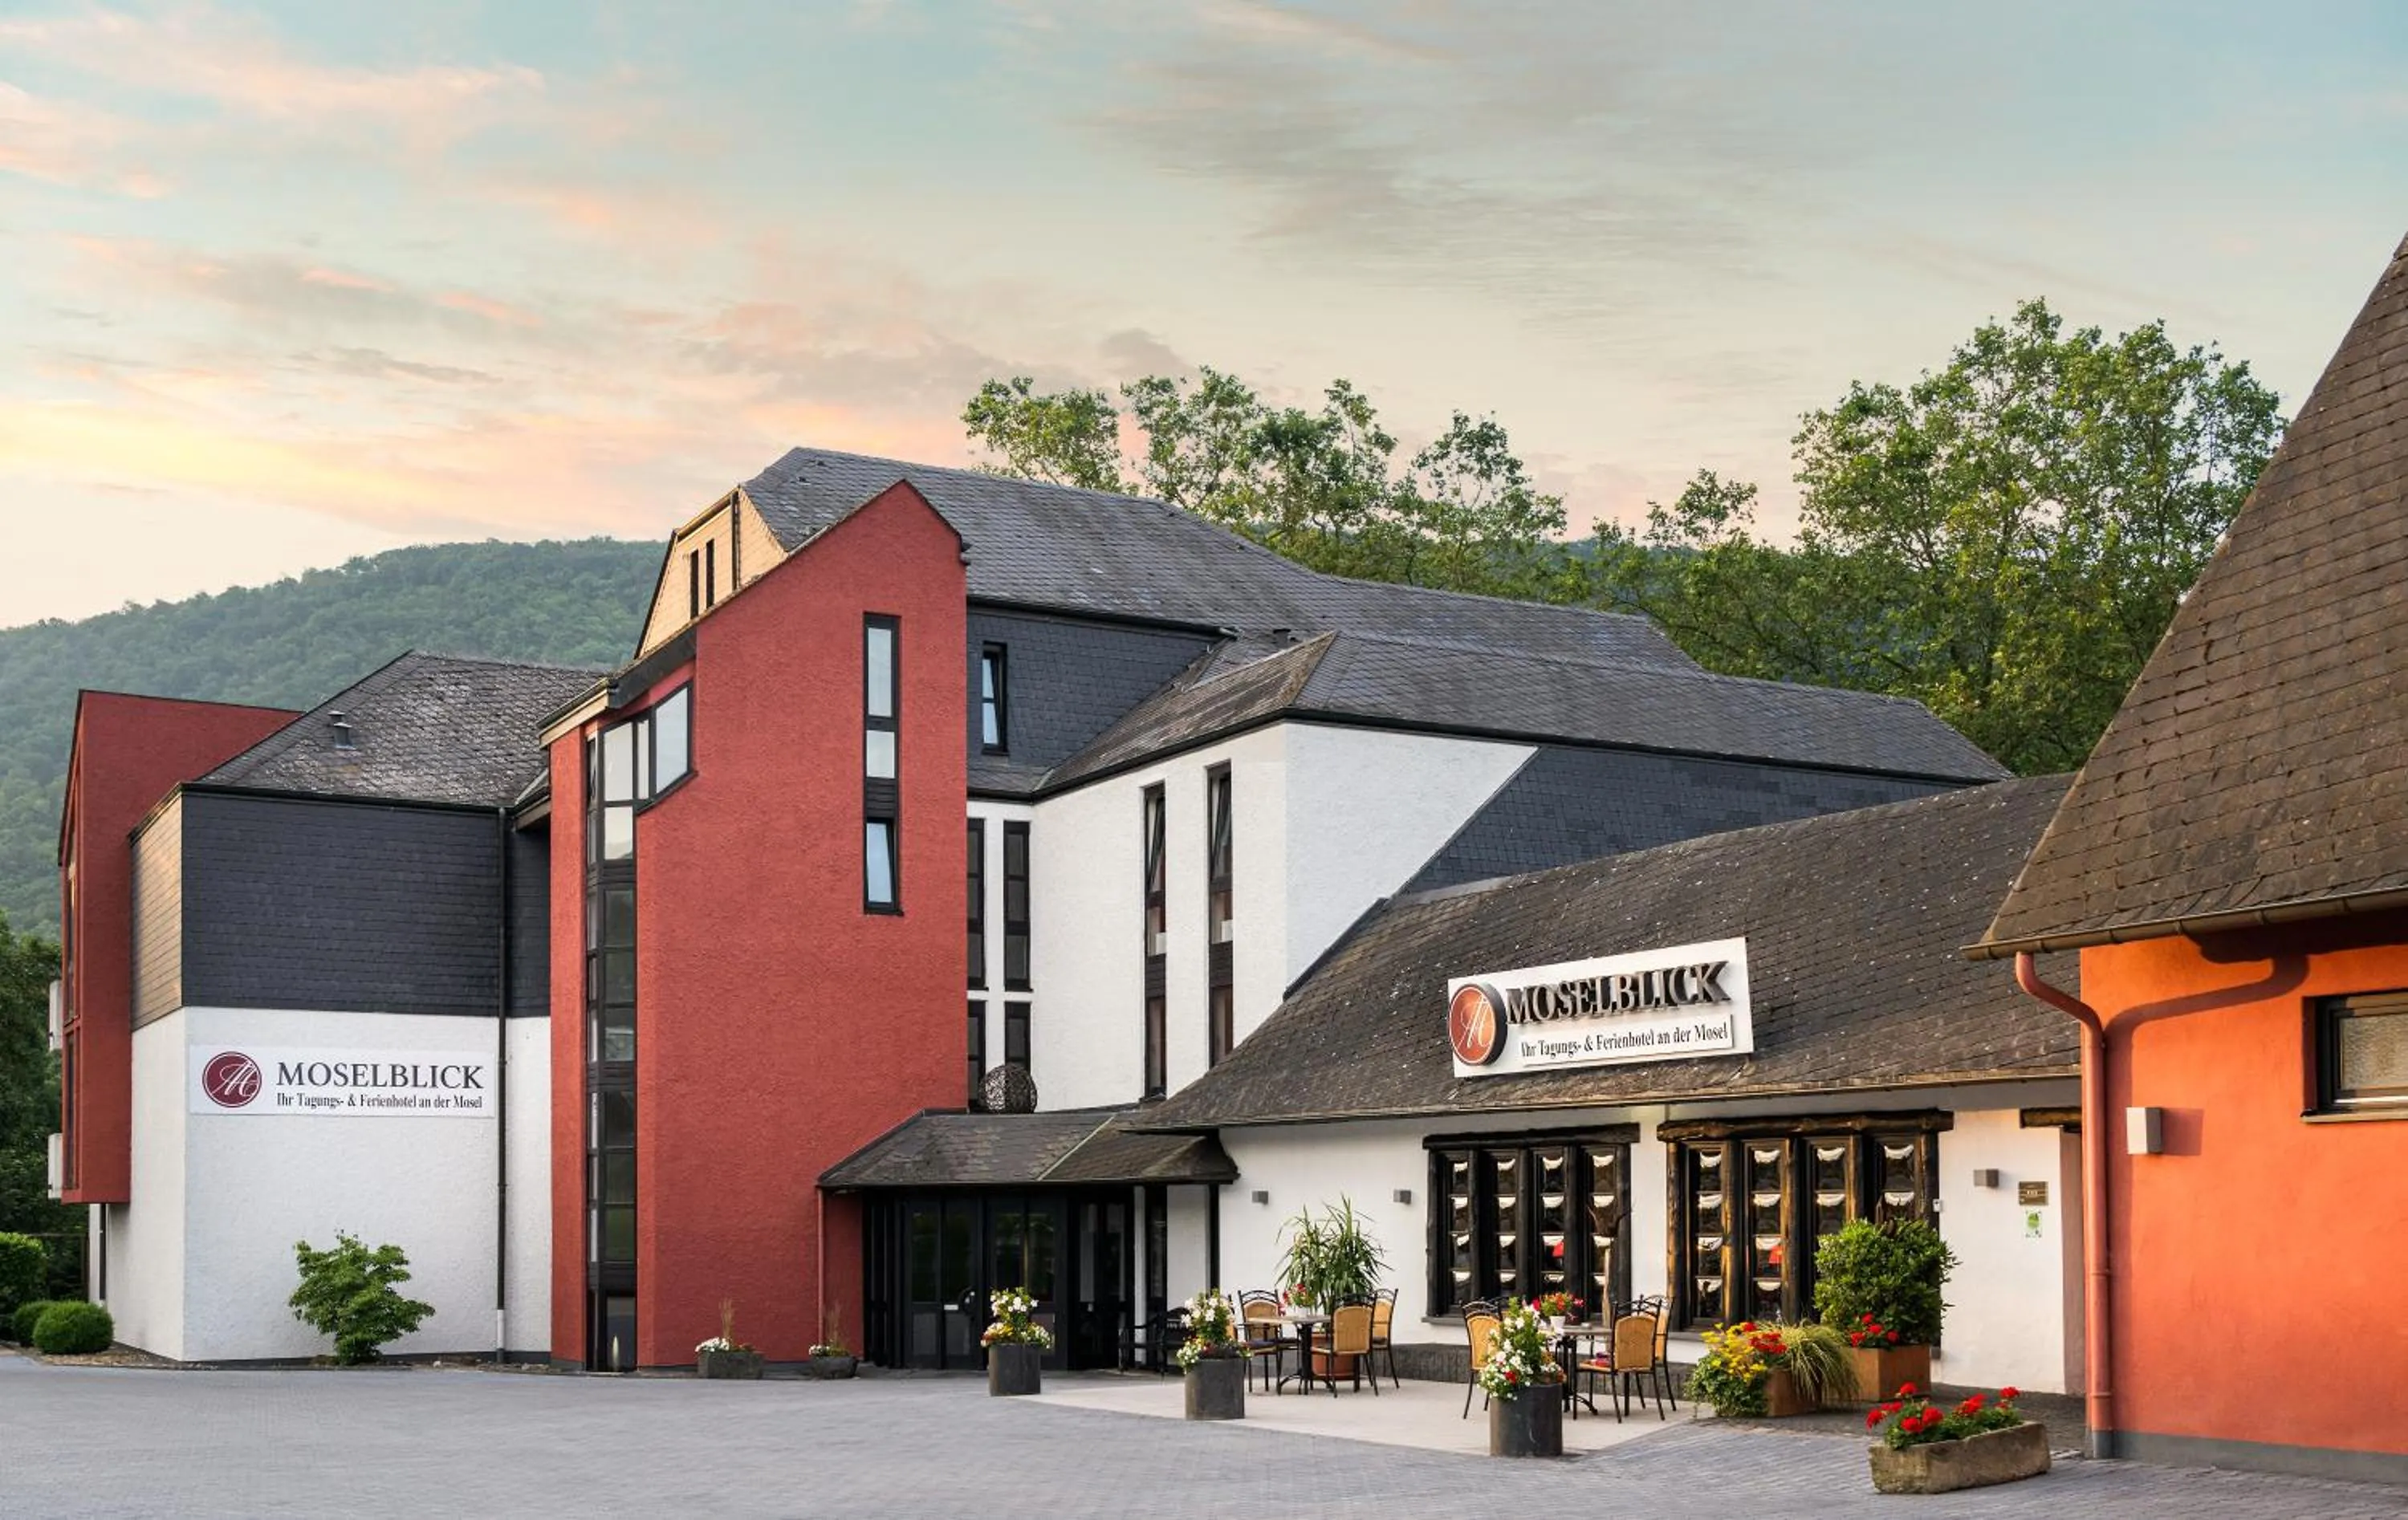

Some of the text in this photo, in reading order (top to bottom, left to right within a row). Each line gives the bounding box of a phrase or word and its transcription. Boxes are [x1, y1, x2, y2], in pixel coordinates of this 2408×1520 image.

[1506, 961, 1731, 1025] MOSELBLICK
[1520, 1022, 1728, 1059] Ihr Tagungs- & Ferienhotel an der Mosel
[276, 1061, 484, 1089] MOSELBLICK
[277, 1092, 482, 1109] Ihr Tagungs- & Ferienhotel an der Mosel
